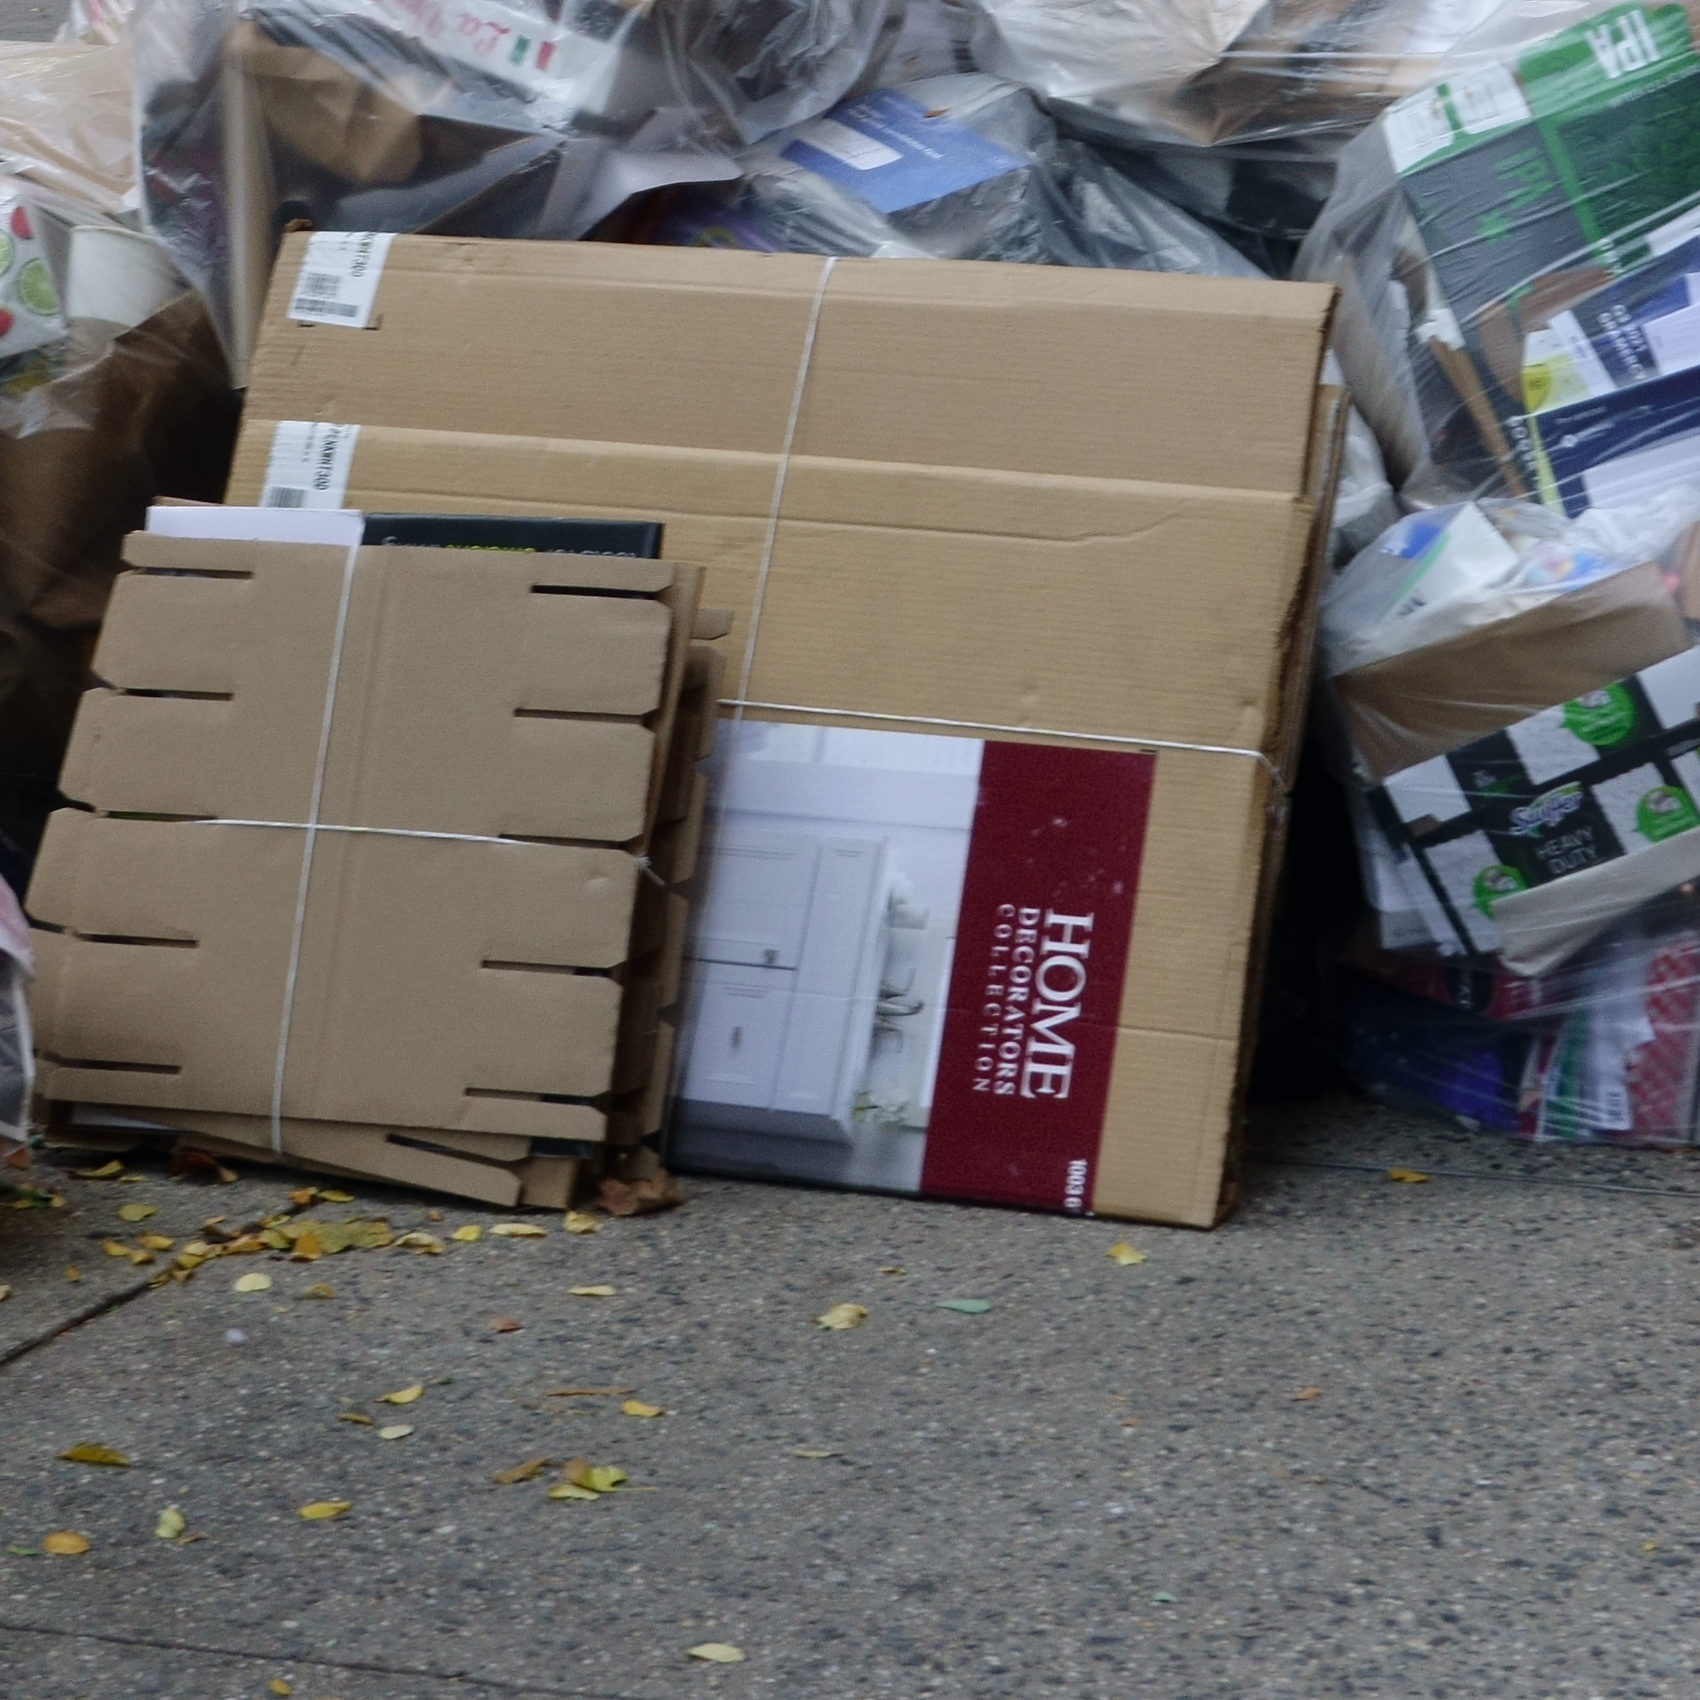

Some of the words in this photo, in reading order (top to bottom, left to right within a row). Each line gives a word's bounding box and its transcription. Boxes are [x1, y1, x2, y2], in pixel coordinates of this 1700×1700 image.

[1586, 8, 1661, 79] IPA
[1534, 826, 1594, 862] HEAVY
[1548, 844, 1599, 877] DUTY
[971, 903, 1016, 1093] COLLECTION
[993, 906, 1041, 1096] DECORATORS
[1019, 909, 1095, 1100] HOME
